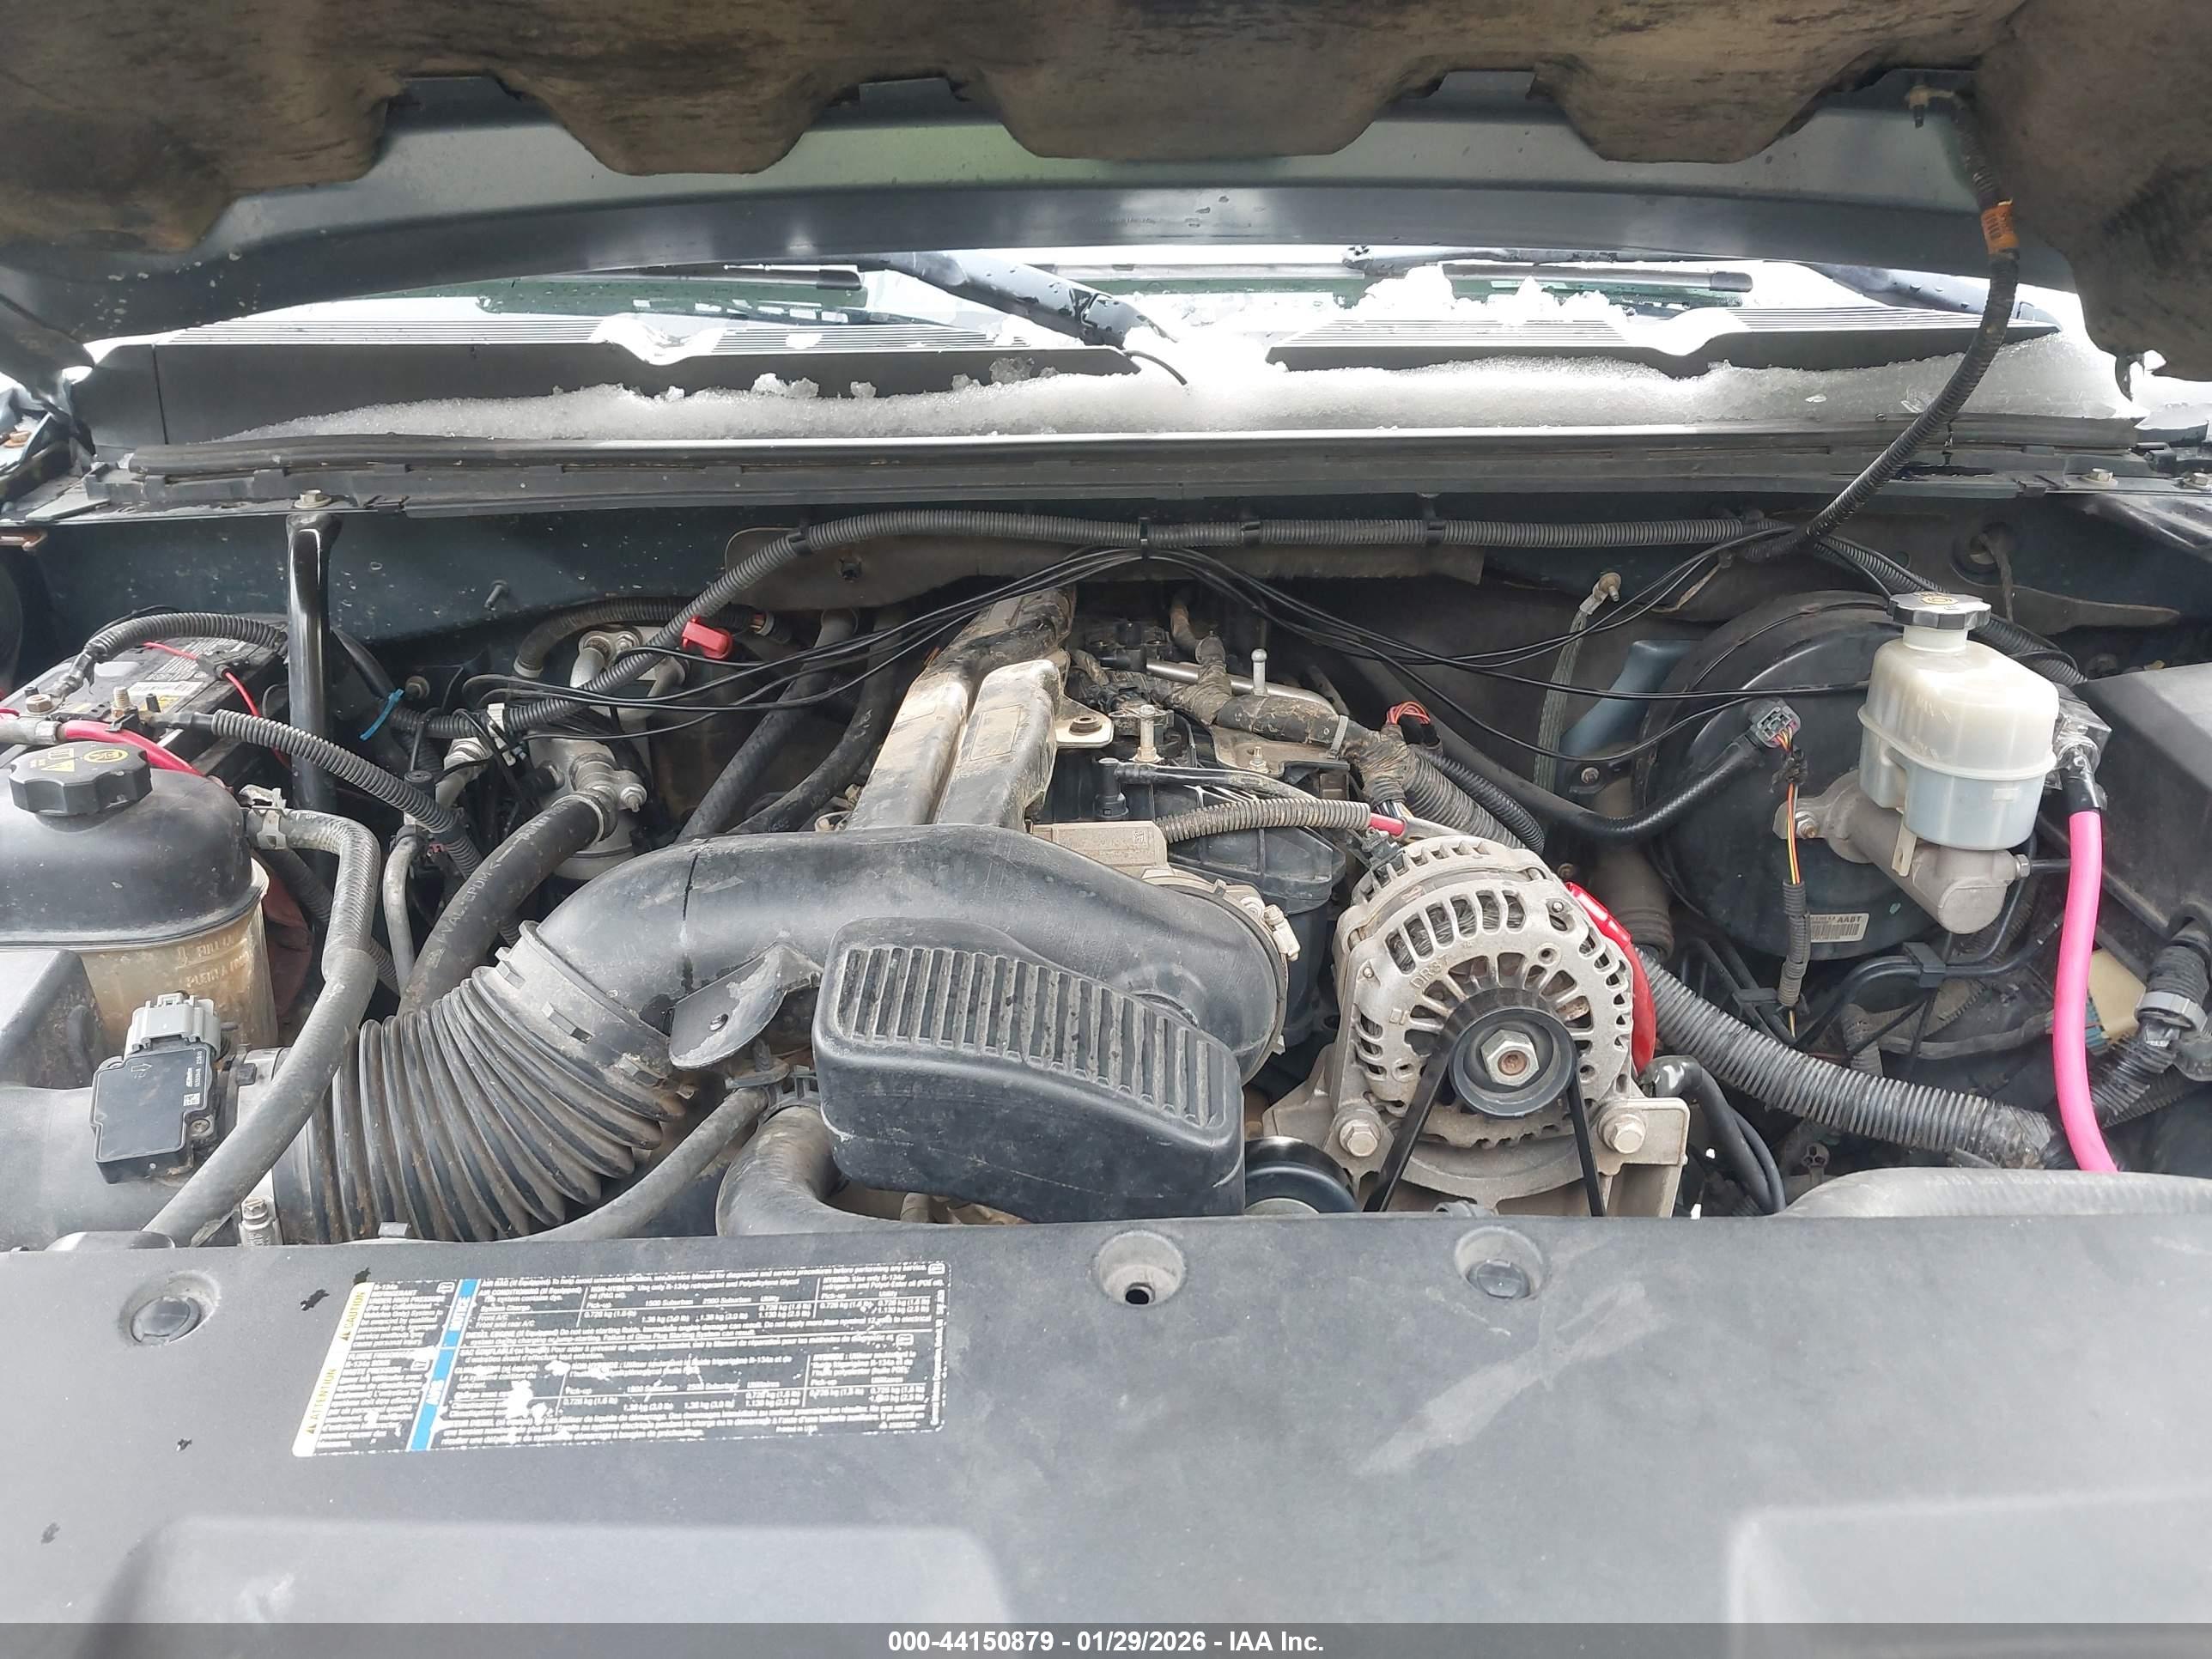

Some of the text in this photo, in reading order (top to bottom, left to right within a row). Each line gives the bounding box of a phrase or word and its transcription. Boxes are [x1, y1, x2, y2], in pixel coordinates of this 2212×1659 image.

[344, 1291, 365, 1328] CAUTION
[448, 1296, 471, 1331] NOTICE
[311, 1368, 337, 1419] ATTENTION
